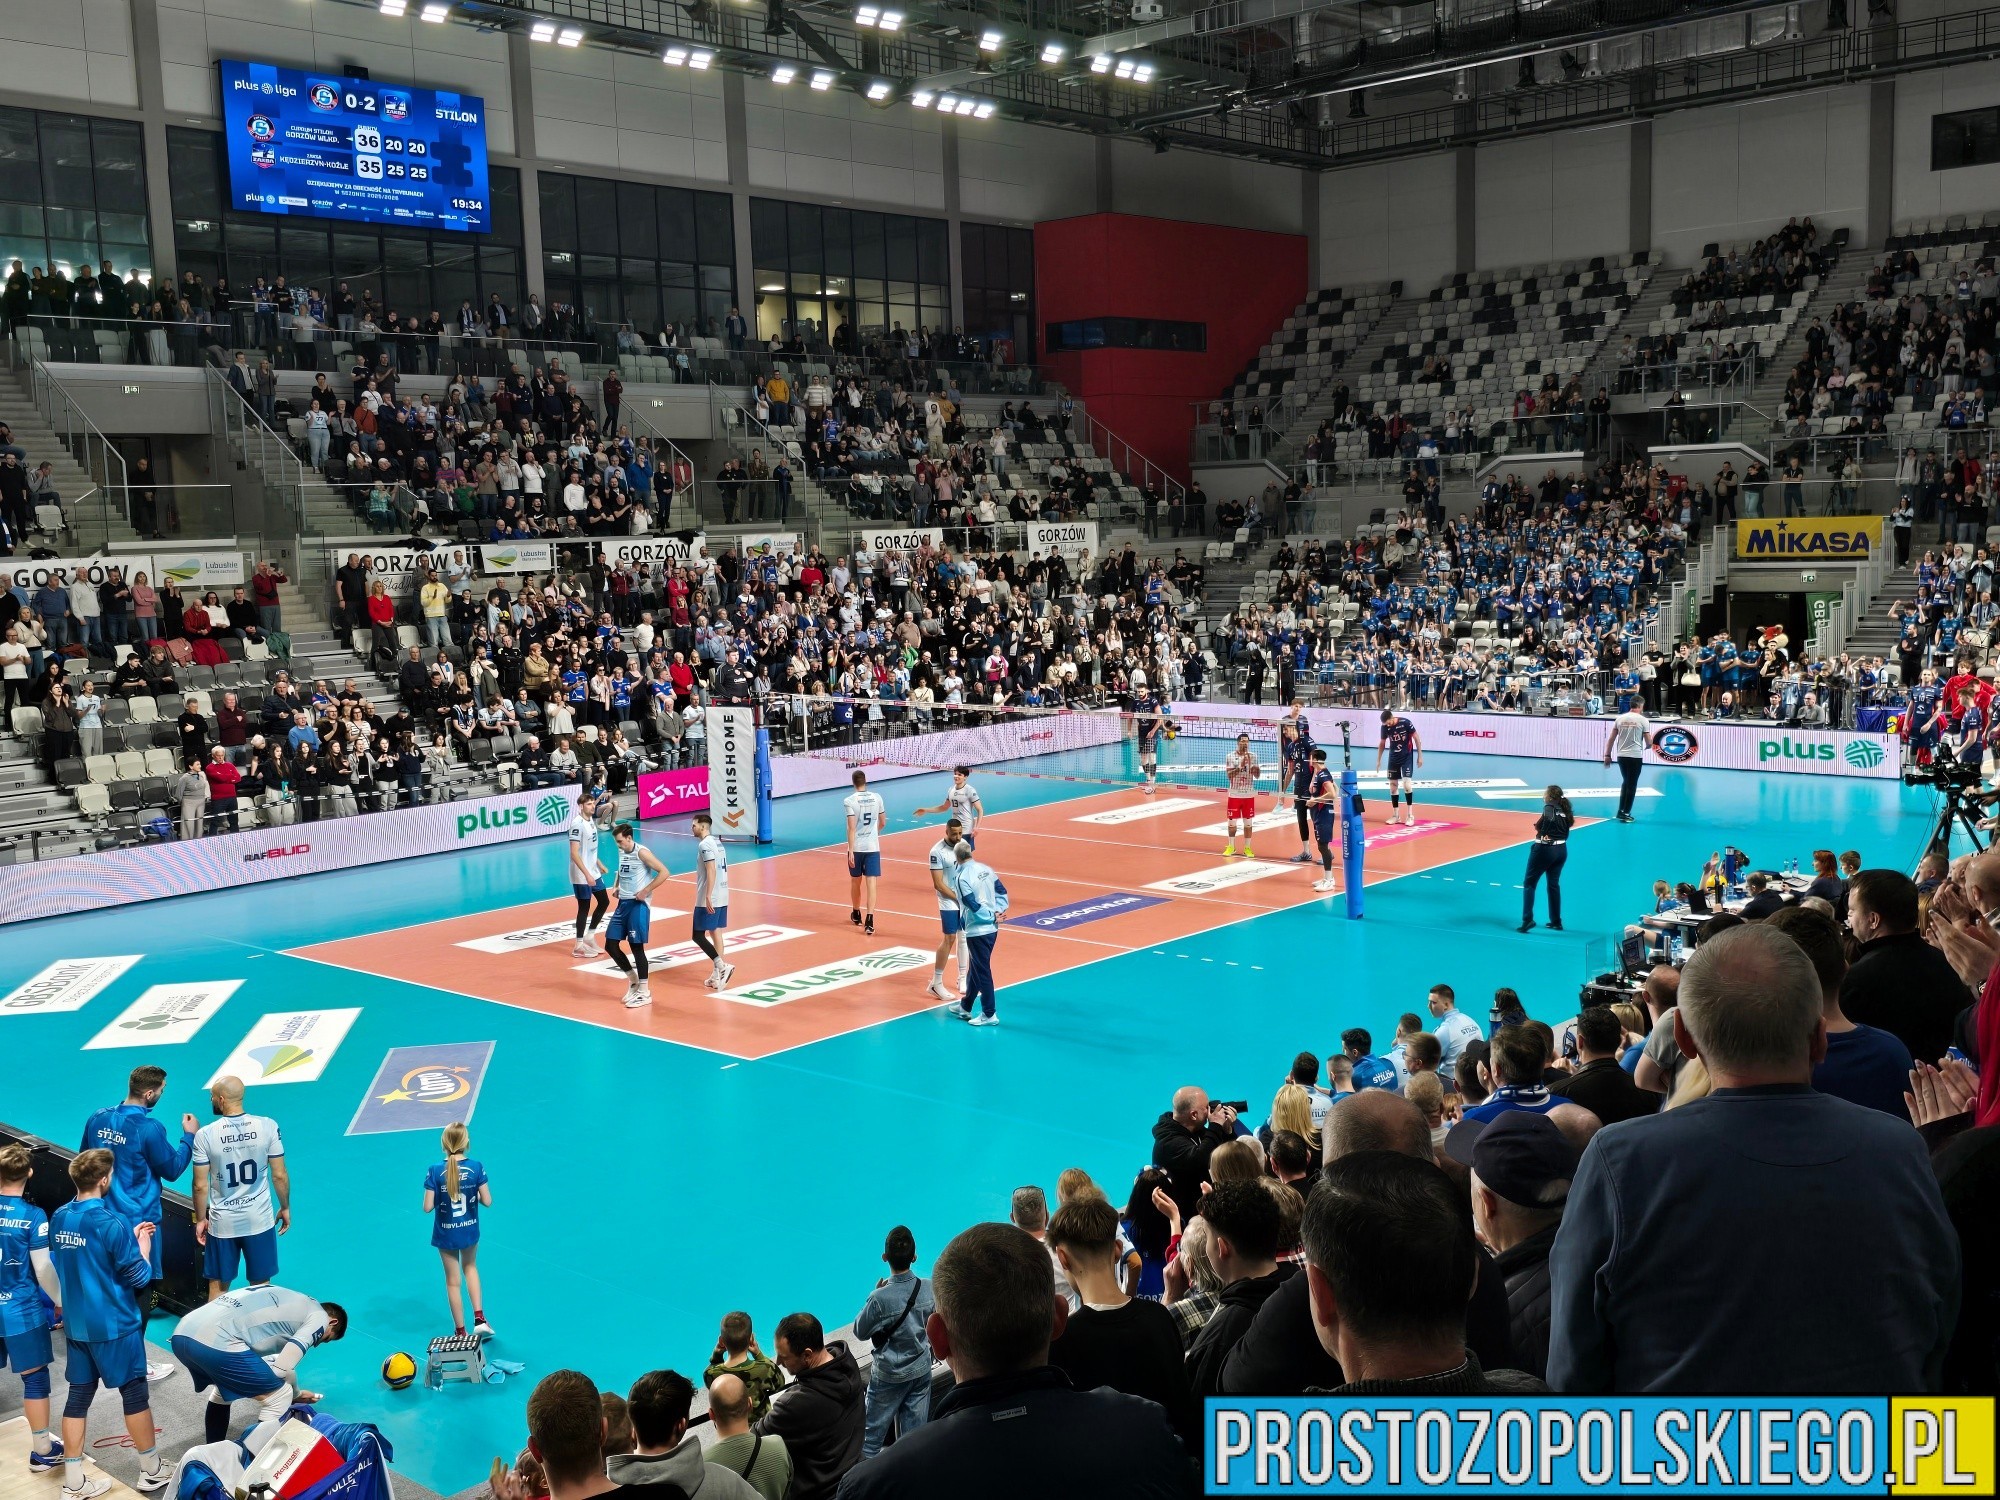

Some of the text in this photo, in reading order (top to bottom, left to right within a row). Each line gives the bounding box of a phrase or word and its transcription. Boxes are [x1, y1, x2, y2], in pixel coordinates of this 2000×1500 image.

[235, 80, 297, 97] plus liga
[435, 109, 477, 123] STILON
[285, 130, 316, 140] GORZÓW
[357, 134, 379, 148] 36
[385, 139, 403, 151] 20
[408, 142, 425, 154] 20
[360, 160, 381, 174] 35
[387, 165, 405, 177] 25
[410, 167, 427, 179] 25
[245, 193, 265, 202] plus
[452, 198, 483, 210] 19:34
[1037, 524, 1087, 542] GORZÓW
[618, 543, 691, 561] GORZÓW
[205, 561, 239, 569] Lubuskie
[13, 560, 129, 588] GORÓW
[1448, 730, 1496, 738] RAFBUD
[1759, 737, 1835, 761] plus
[723, 714, 738, 808] KRISHOME
[456, 805, 528, 838] plus
[863, 813, 871, 826] 5
[244, 844, 311, 862] RAFBUD
[721, 857, 727, 872] 4
[738, 968, 864, 1003] plus
[1372, 1071, 1395, 1084] STILON
[97, 1129, 127, 1145] STILON
[220, 1131, 257, 1144] VELOSO
[226, 1159, 257, 1188] 10
[451, 1193, 467, 1218] 9
[55, 1234, 87, 1247] STILON
